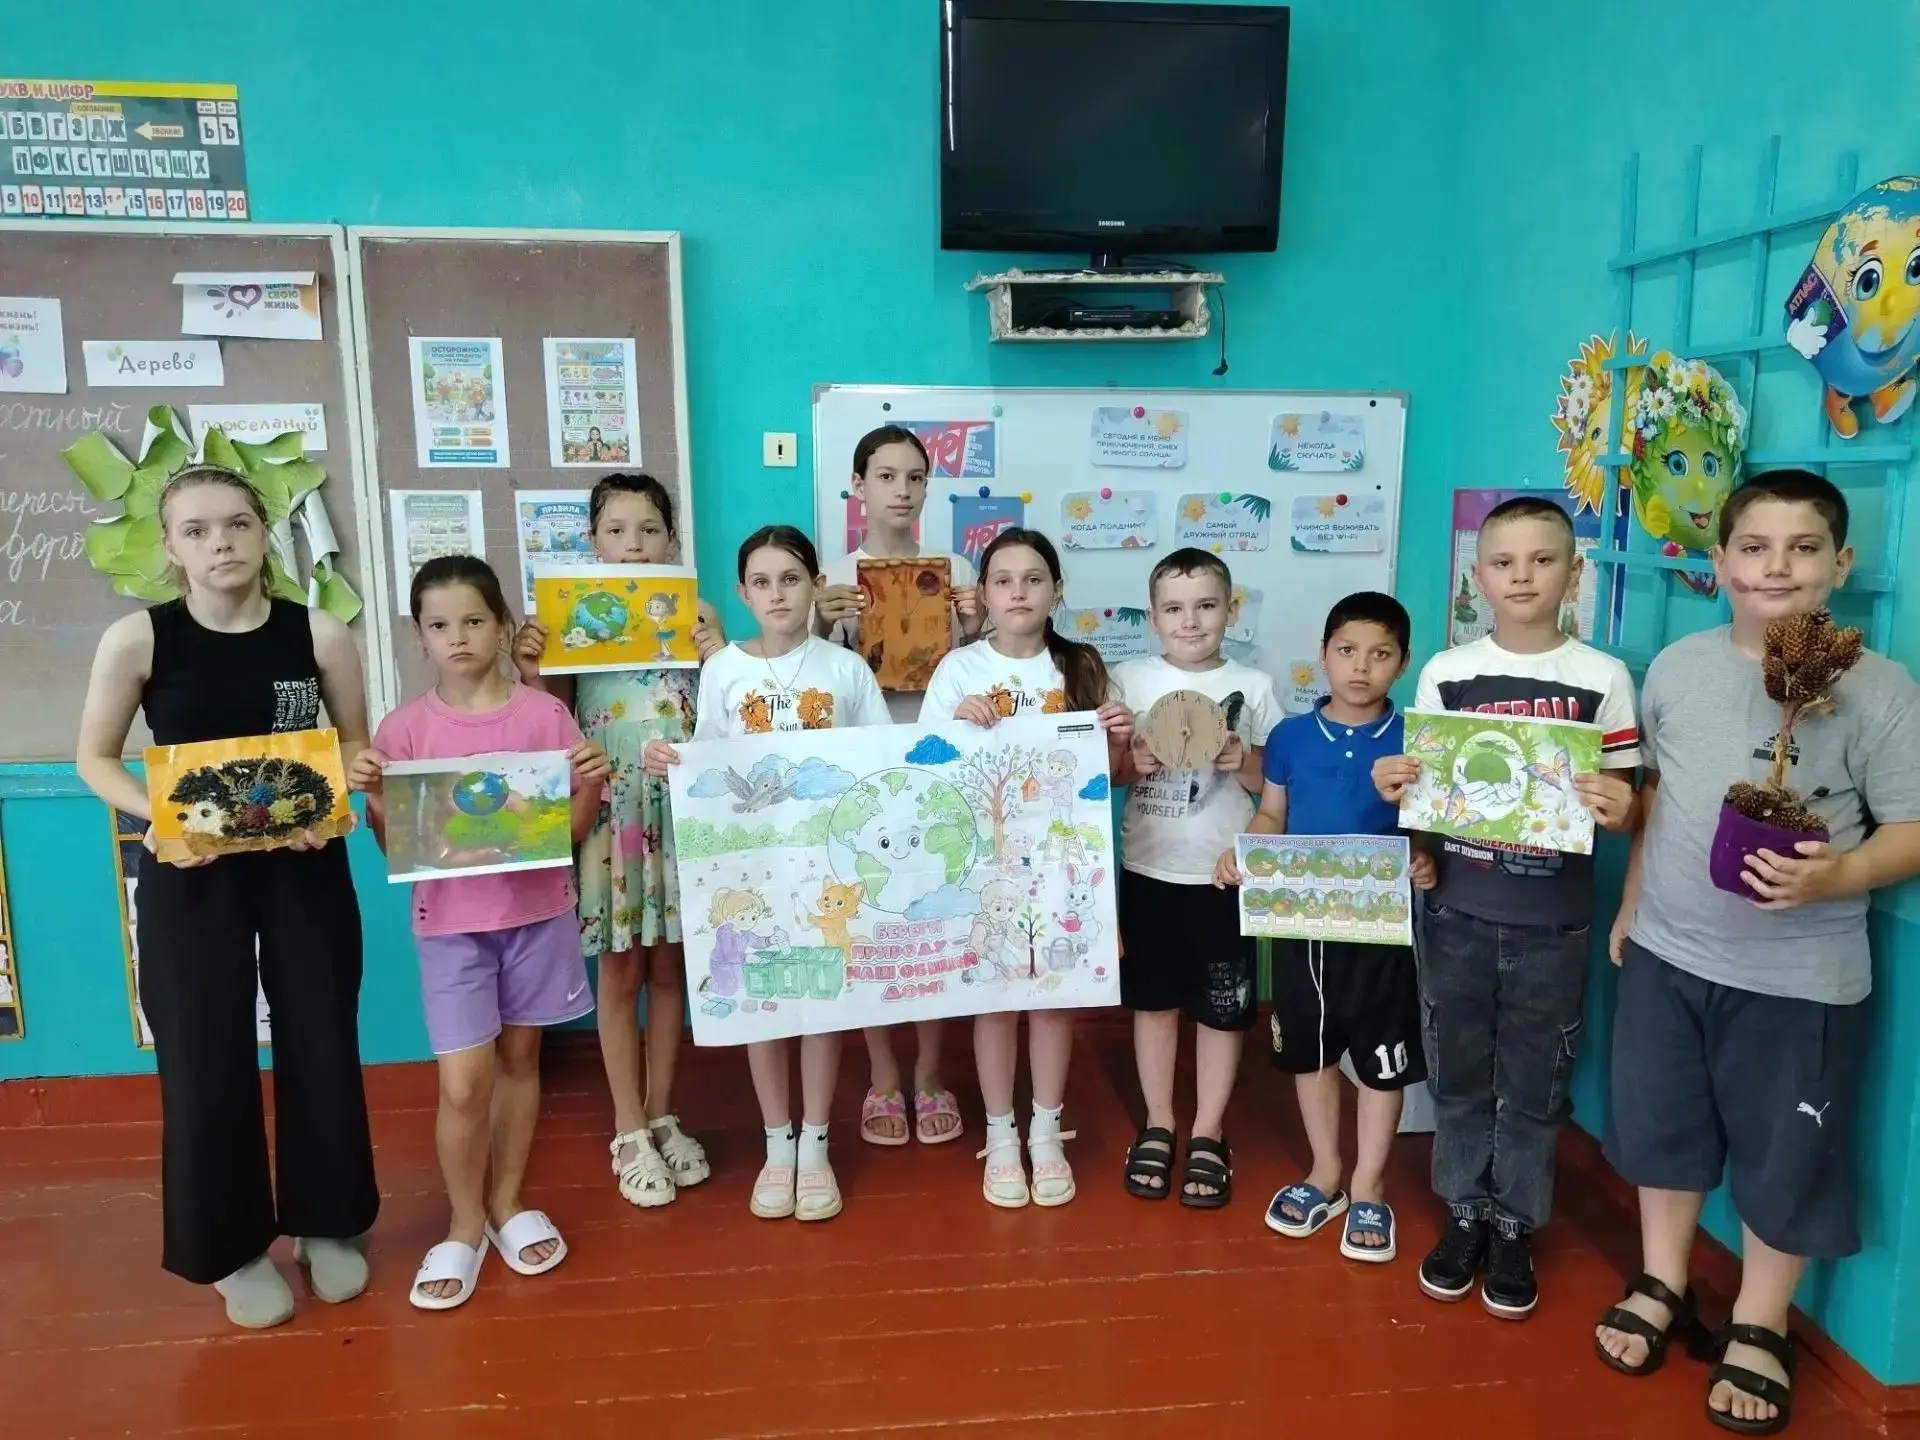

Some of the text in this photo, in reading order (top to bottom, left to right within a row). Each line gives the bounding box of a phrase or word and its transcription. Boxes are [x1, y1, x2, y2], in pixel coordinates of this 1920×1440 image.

[47, 83, 94, 100] ЦИФР
[53, 118, 64, 136] Г
[72, 117, 82, 137] З
[107, 119, 125, 138] Ж
[15, 151, 207, 177] П Ф К С Т Ш Ц Ч Щ Х
[7, 192, 16, 207] 9
[23, 192, 40, 207] 10
[46, 193, 60, 208] 11
[65, 193, 83, 209] 12
[86, 193, 103, 209] 13
[129, 194, 144, 210] 15
[147, 195, 163, 210] 16
[167, 195, 184, 210] 17
[187, 196, 203, 211] 18
[207, 196, 225, 211] 19
[228, 197, 245, 212] 20
[1788, 272, 1818, 316] АТЛАС
[264, 301, 299, 310] ЖИЗНЬ
[118, 351, 194, 375] Дерево
[1103, 432, 1138, 441] СЕГОДНЯ
[1297, 442, 1336, 450] НЕКОГДА
[541, 504, 580, 514] ПРАВИЛА
[1071, 524, 1098, 532] КОГДА
[1205, 520, 1238, 529] САМЫЙ
[1183, 530, 1259, 539] ДРУЖНЫЙ ОТРЯД!
[1006, 690, 1036, 717] The
[1173, 690, 1187, 702] 12
[765, 694, 793, 722] The
[779, 721, 798, 732] Sun
[1135, 785, 1188, 802] SPECIAL BE
[1136, 801, 1186, 819] YOURSELF
[1461, 845, 1494, 861] DIVISION
[875, 919, 943, 940] БЕРЕГИ
[851, 939, 948, 960] ПРИРОДУ
[845, 965, 897, 981] НАШ
[1374, 1040, 1408, 1080] 10
[1358, 1219, 1382, 1227] adidas
